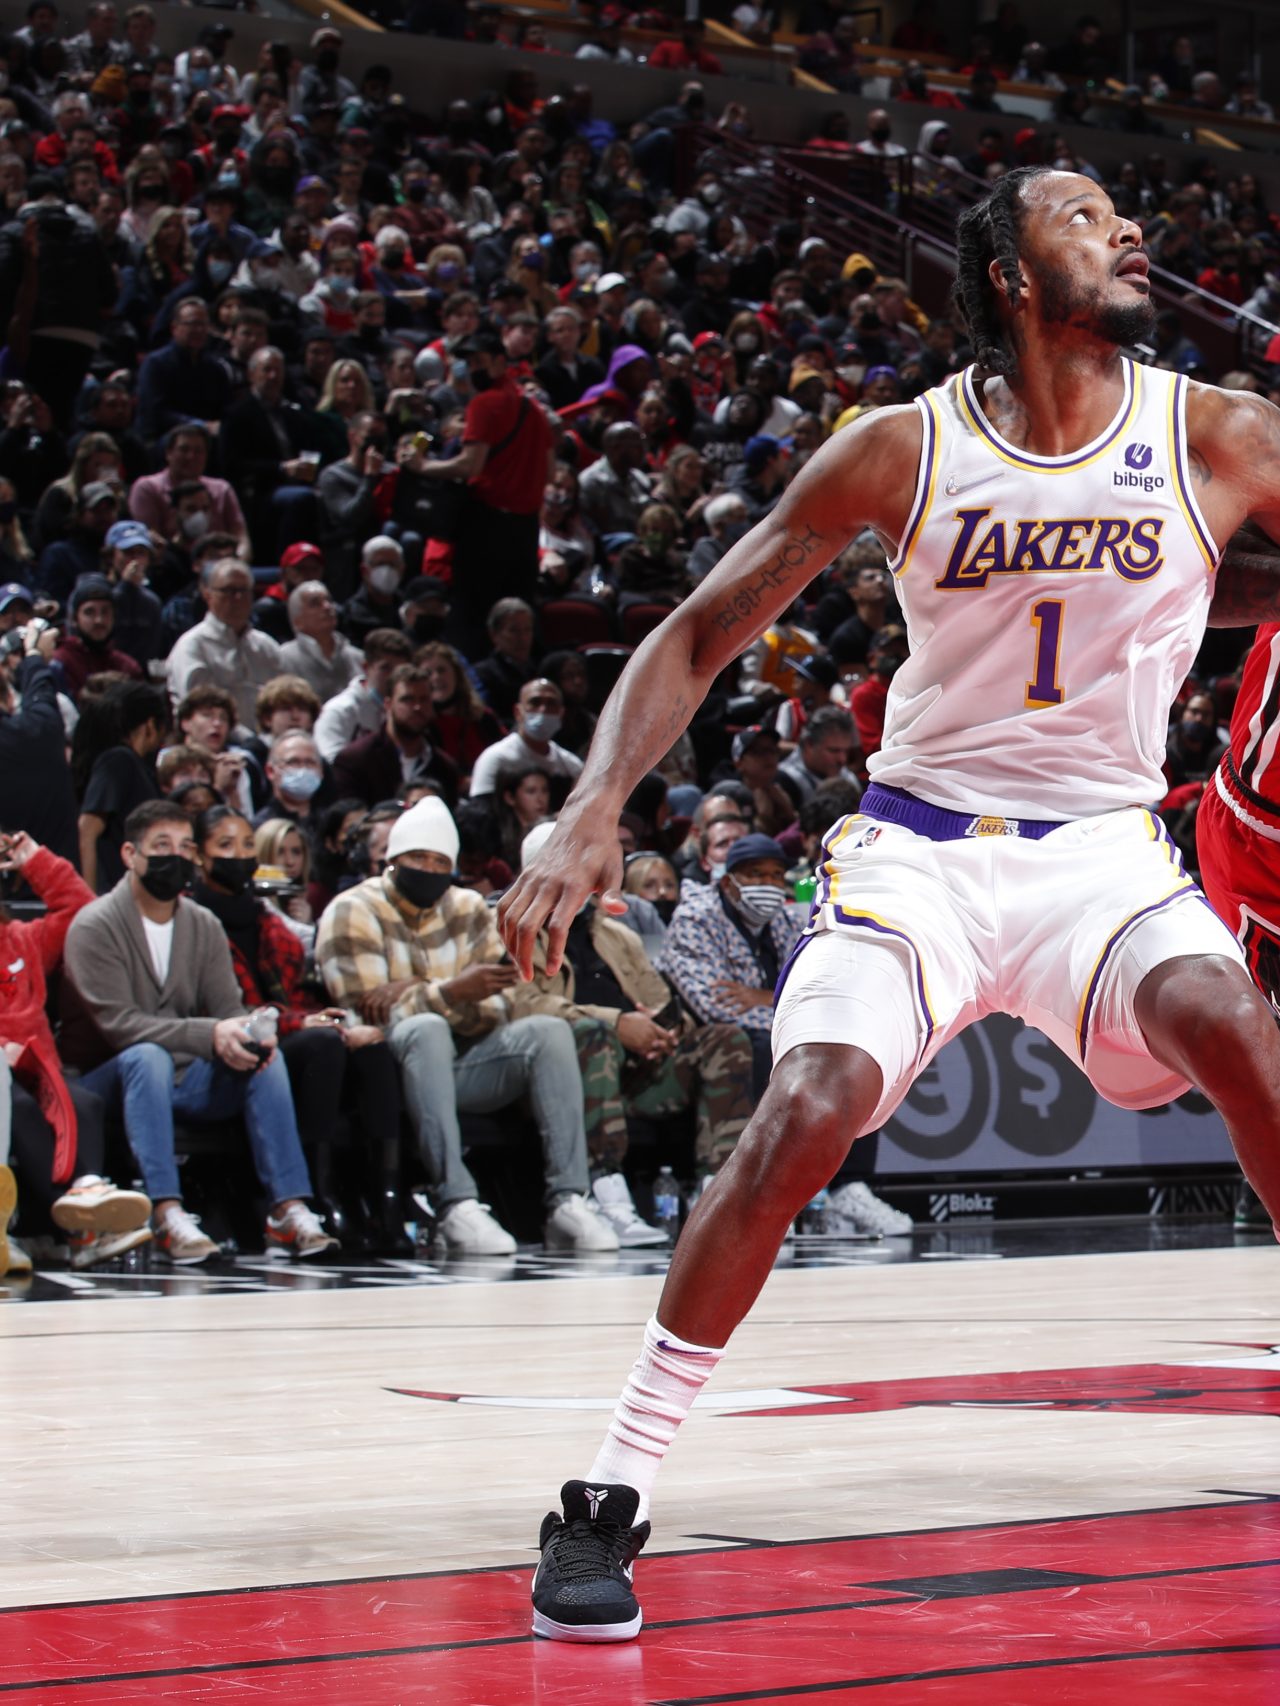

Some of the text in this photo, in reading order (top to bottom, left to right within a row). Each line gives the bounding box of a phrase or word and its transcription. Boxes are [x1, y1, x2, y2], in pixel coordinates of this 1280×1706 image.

[1113, 471, 1165, 493] bibigo
[934, 506, 1166, 592] LAKERS
[1024, 597, 1066, 709] 1
[970, 817, 1017, 836] LAKERS
[949, 1192, 994, 1213] Blokz
